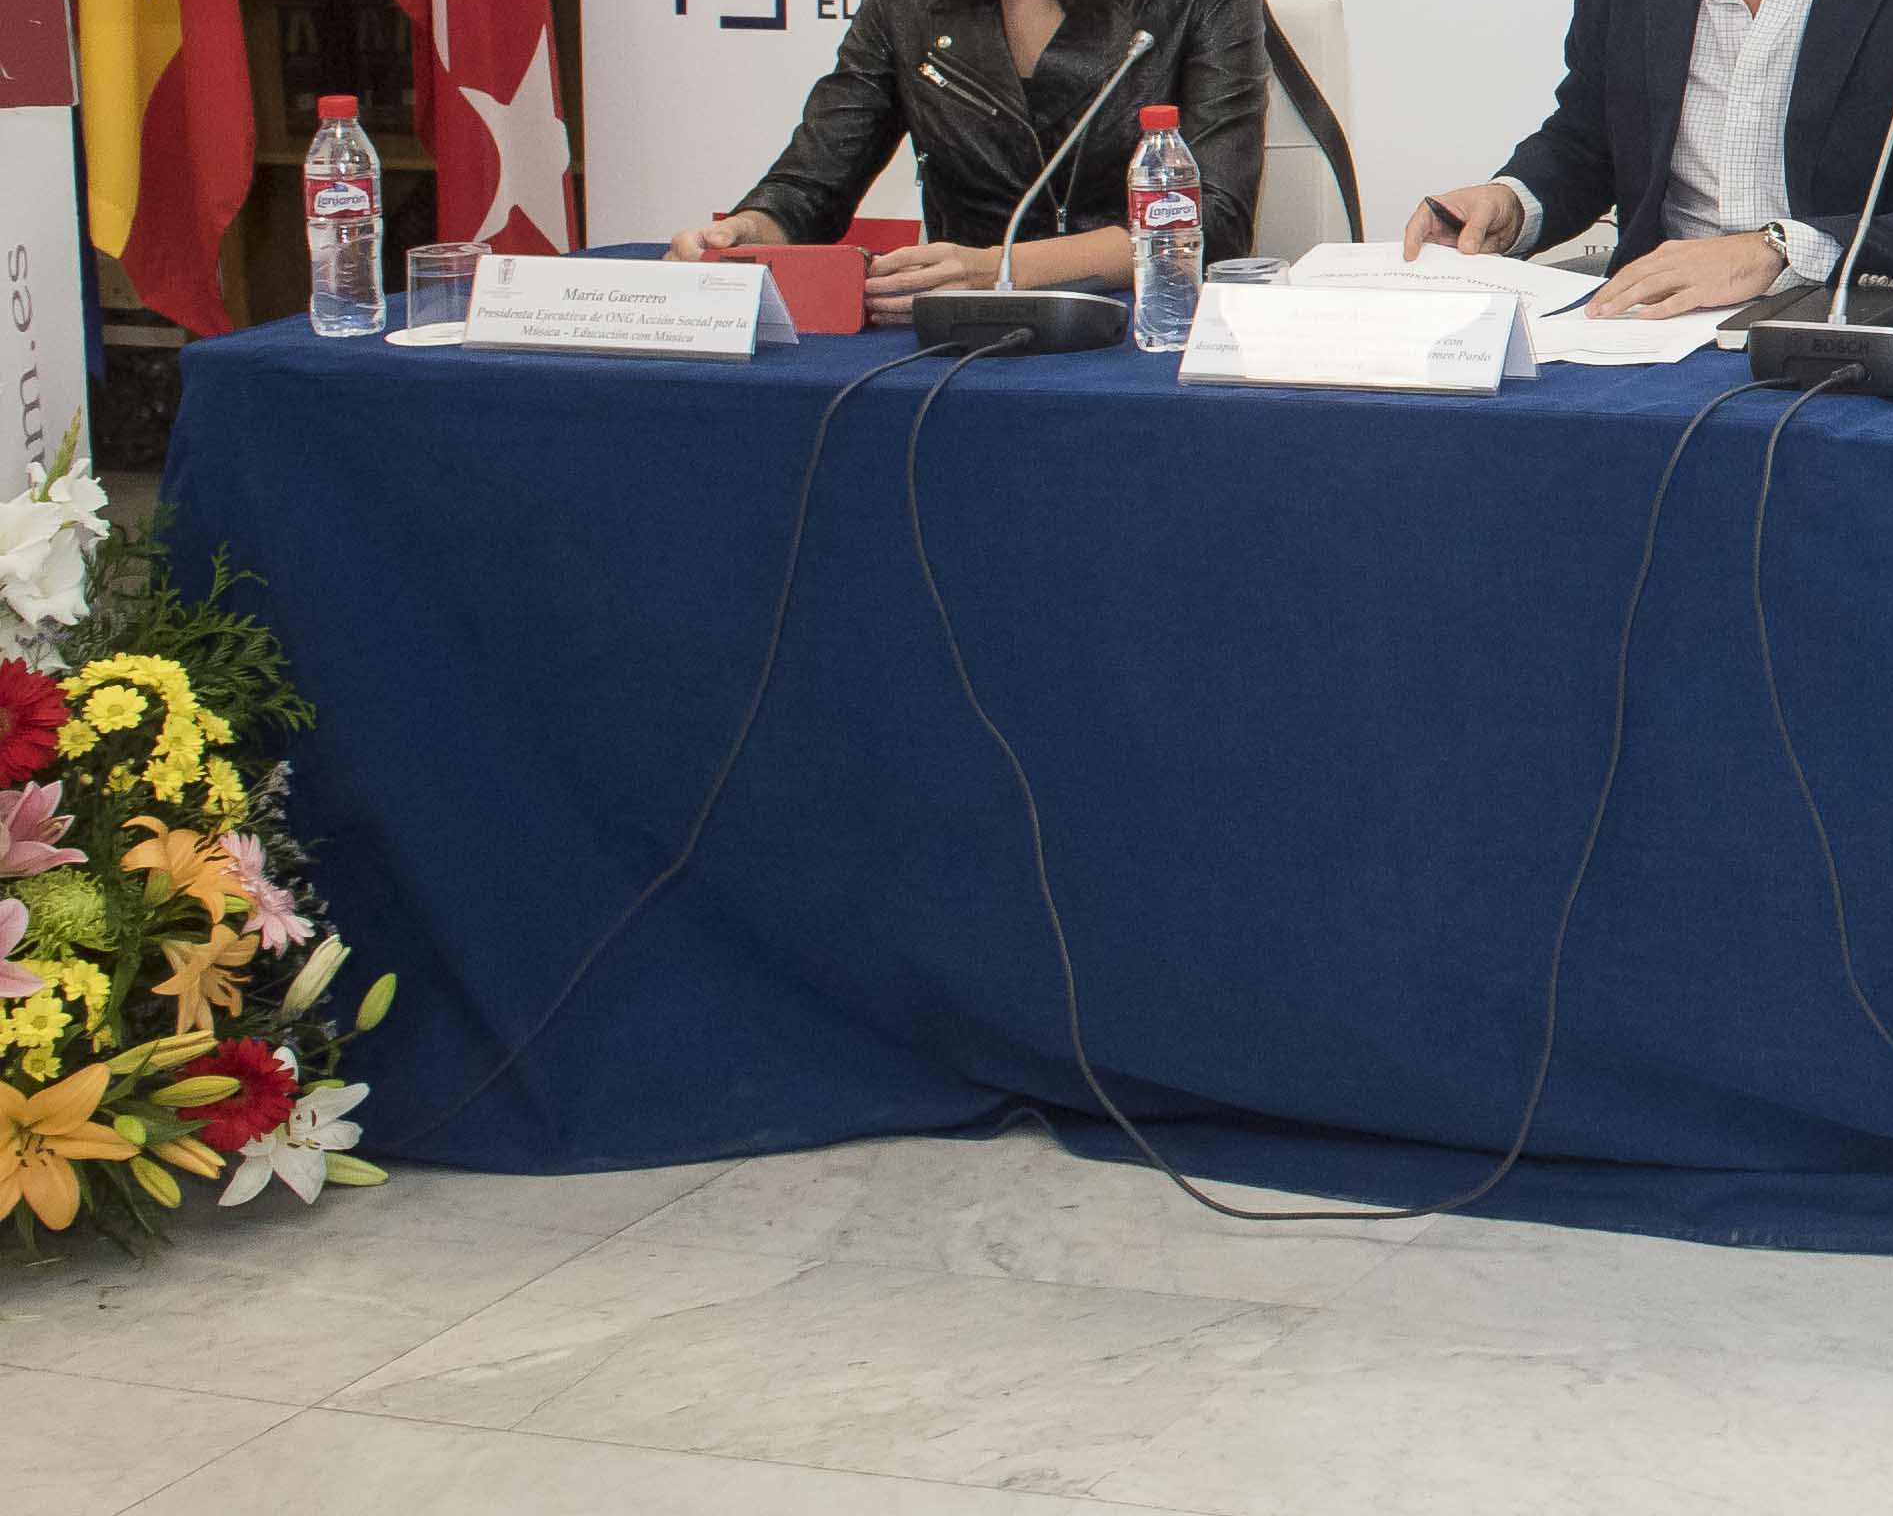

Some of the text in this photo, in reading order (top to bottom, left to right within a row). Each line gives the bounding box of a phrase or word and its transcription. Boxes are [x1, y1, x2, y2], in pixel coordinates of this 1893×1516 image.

[608, 290, 666, 304] Guerrero
[477, 307, 533, 321] Presidenta
[605, 311, 633, 323] ONG
[676, 315, 711, 327] Social
